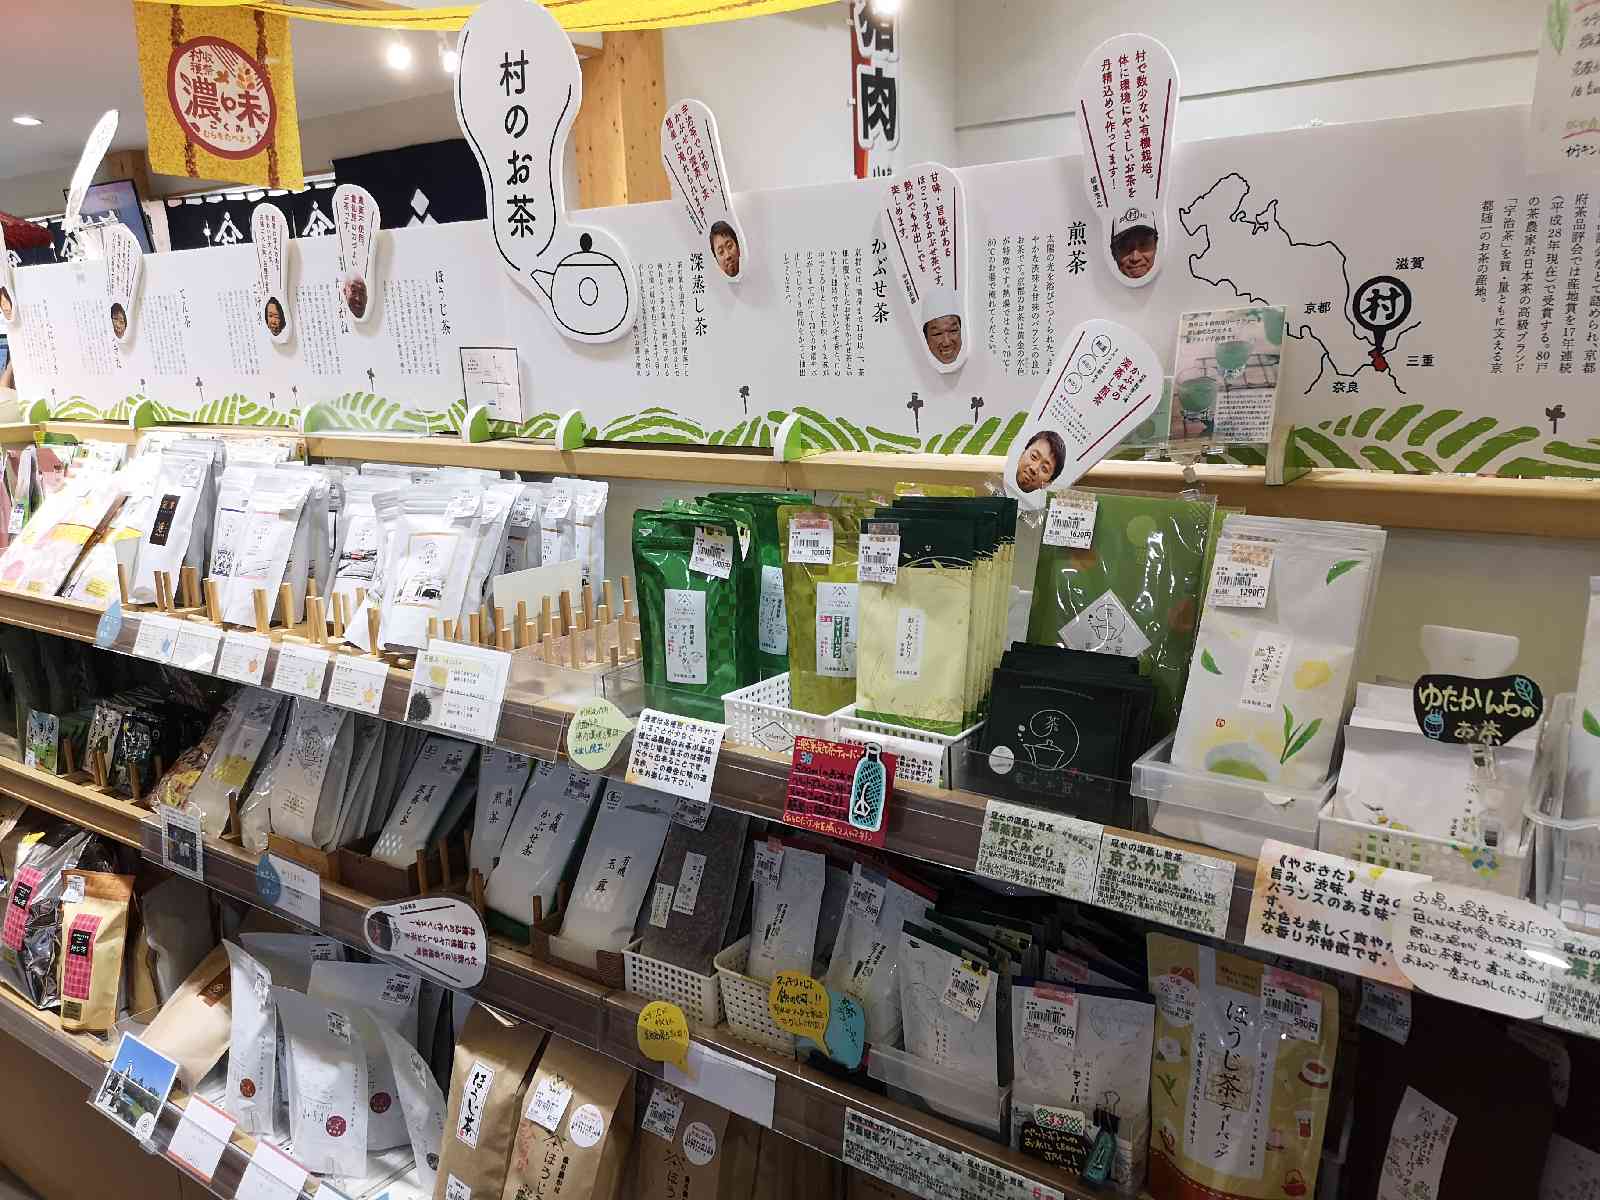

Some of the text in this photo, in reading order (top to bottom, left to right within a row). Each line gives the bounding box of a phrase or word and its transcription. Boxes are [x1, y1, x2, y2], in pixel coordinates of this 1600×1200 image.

[1118, 54, 1136, 199] 体に環境にやさしいお茶を
[1135, 49, 1154, 179] 村で数少ない有機栽培。
[500, 49, 536, 238] 村のお茶
[890, 184, 910, 240] 楽しめます。
[918, 175, 944, 287] ほっこりするかぶせ茶です。
[930, 171, 951, 257] 甘味・旨味がある
[1066, 221, 1088, 276] 煎茶
[1396, 256, 1425, 271] 滋賀
[1474, 199, 1495, 304] 都随一のお茶の産地。
[689, 252, 708, 337] 深蒸し茶
[872, 239, 890, 324] かぶせ茶
[1304, 301, 1331, 315] 京都
[1360, 287, 1406, 322] 村
[1515, 196, 1541, 374] の茶農家が日本茶の高級ブランド
[1559, 193, 1590, 375] 府茶品評会では産地賞を17年連続
[1332, 382, 1360, 394] 奈良
[1406, 354, 1435, 368] 三重
[1418, 682, 1536, 719] ゆたかんちの
[1454, 719, 1505, 746] お茶
[998, 836, 1055, 859] おくみどり
[1265, 895, 1286, 910] す。
[1267, 882, 1398, 923] バランスのある味
[1260, 922, 1389, 967] な香りが特徴です。
[461, 1071, 487, 1139] ほうじ茶
